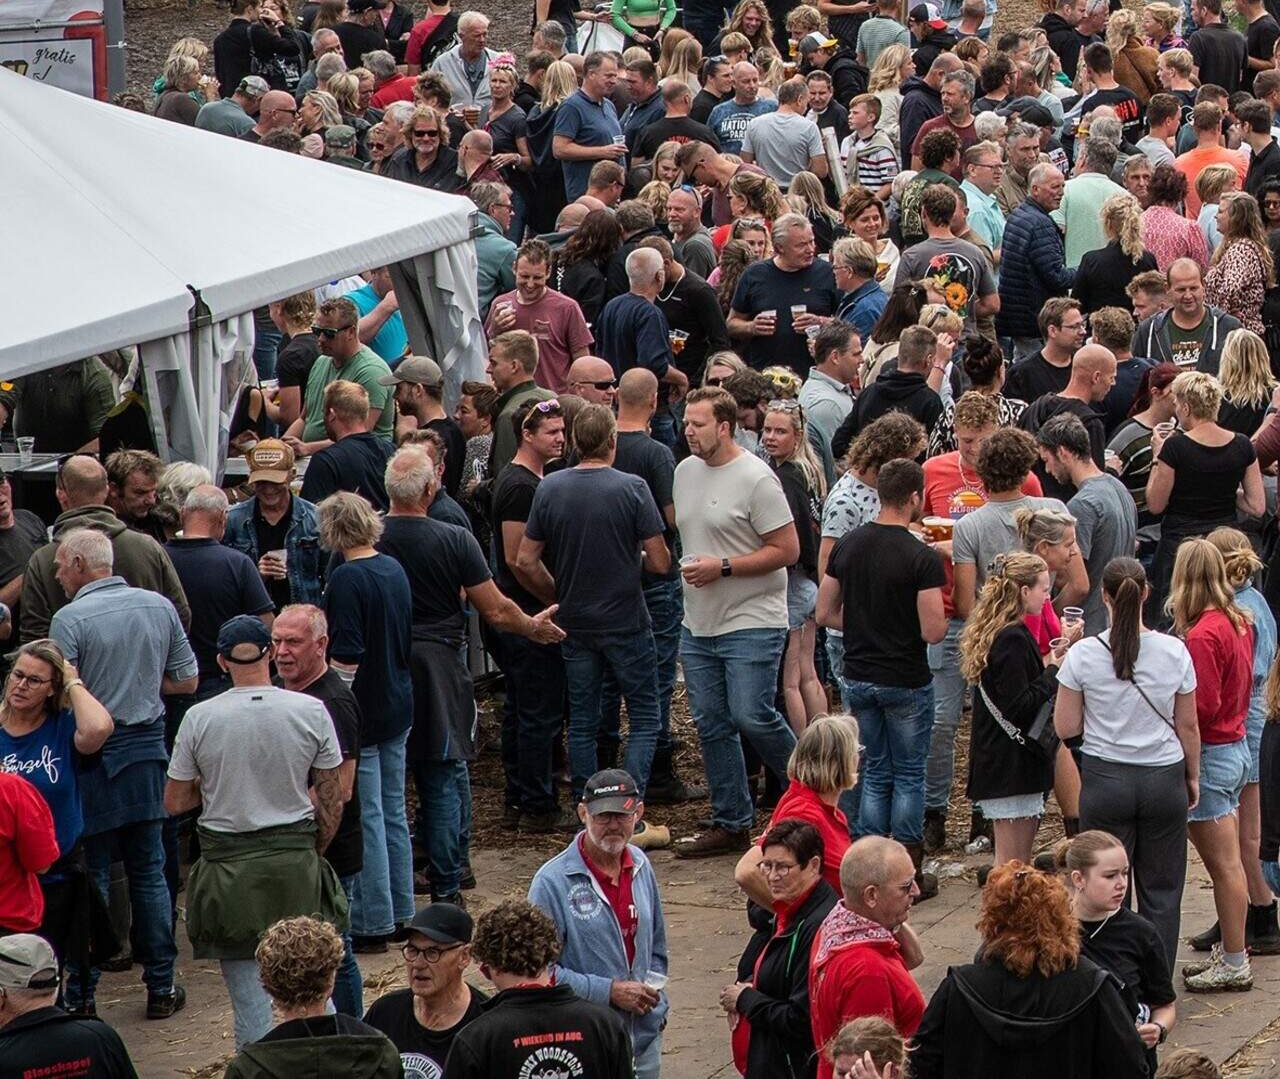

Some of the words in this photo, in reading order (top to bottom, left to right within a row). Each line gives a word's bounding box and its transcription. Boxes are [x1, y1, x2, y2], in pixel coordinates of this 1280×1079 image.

[33, 47, 77, 66] gratis
[520, 1032, 554, 1046] WEEKEND
[555, 1032, 564, 1042] IN
[535, 1046, 584, 1077] WOODSTOCK
